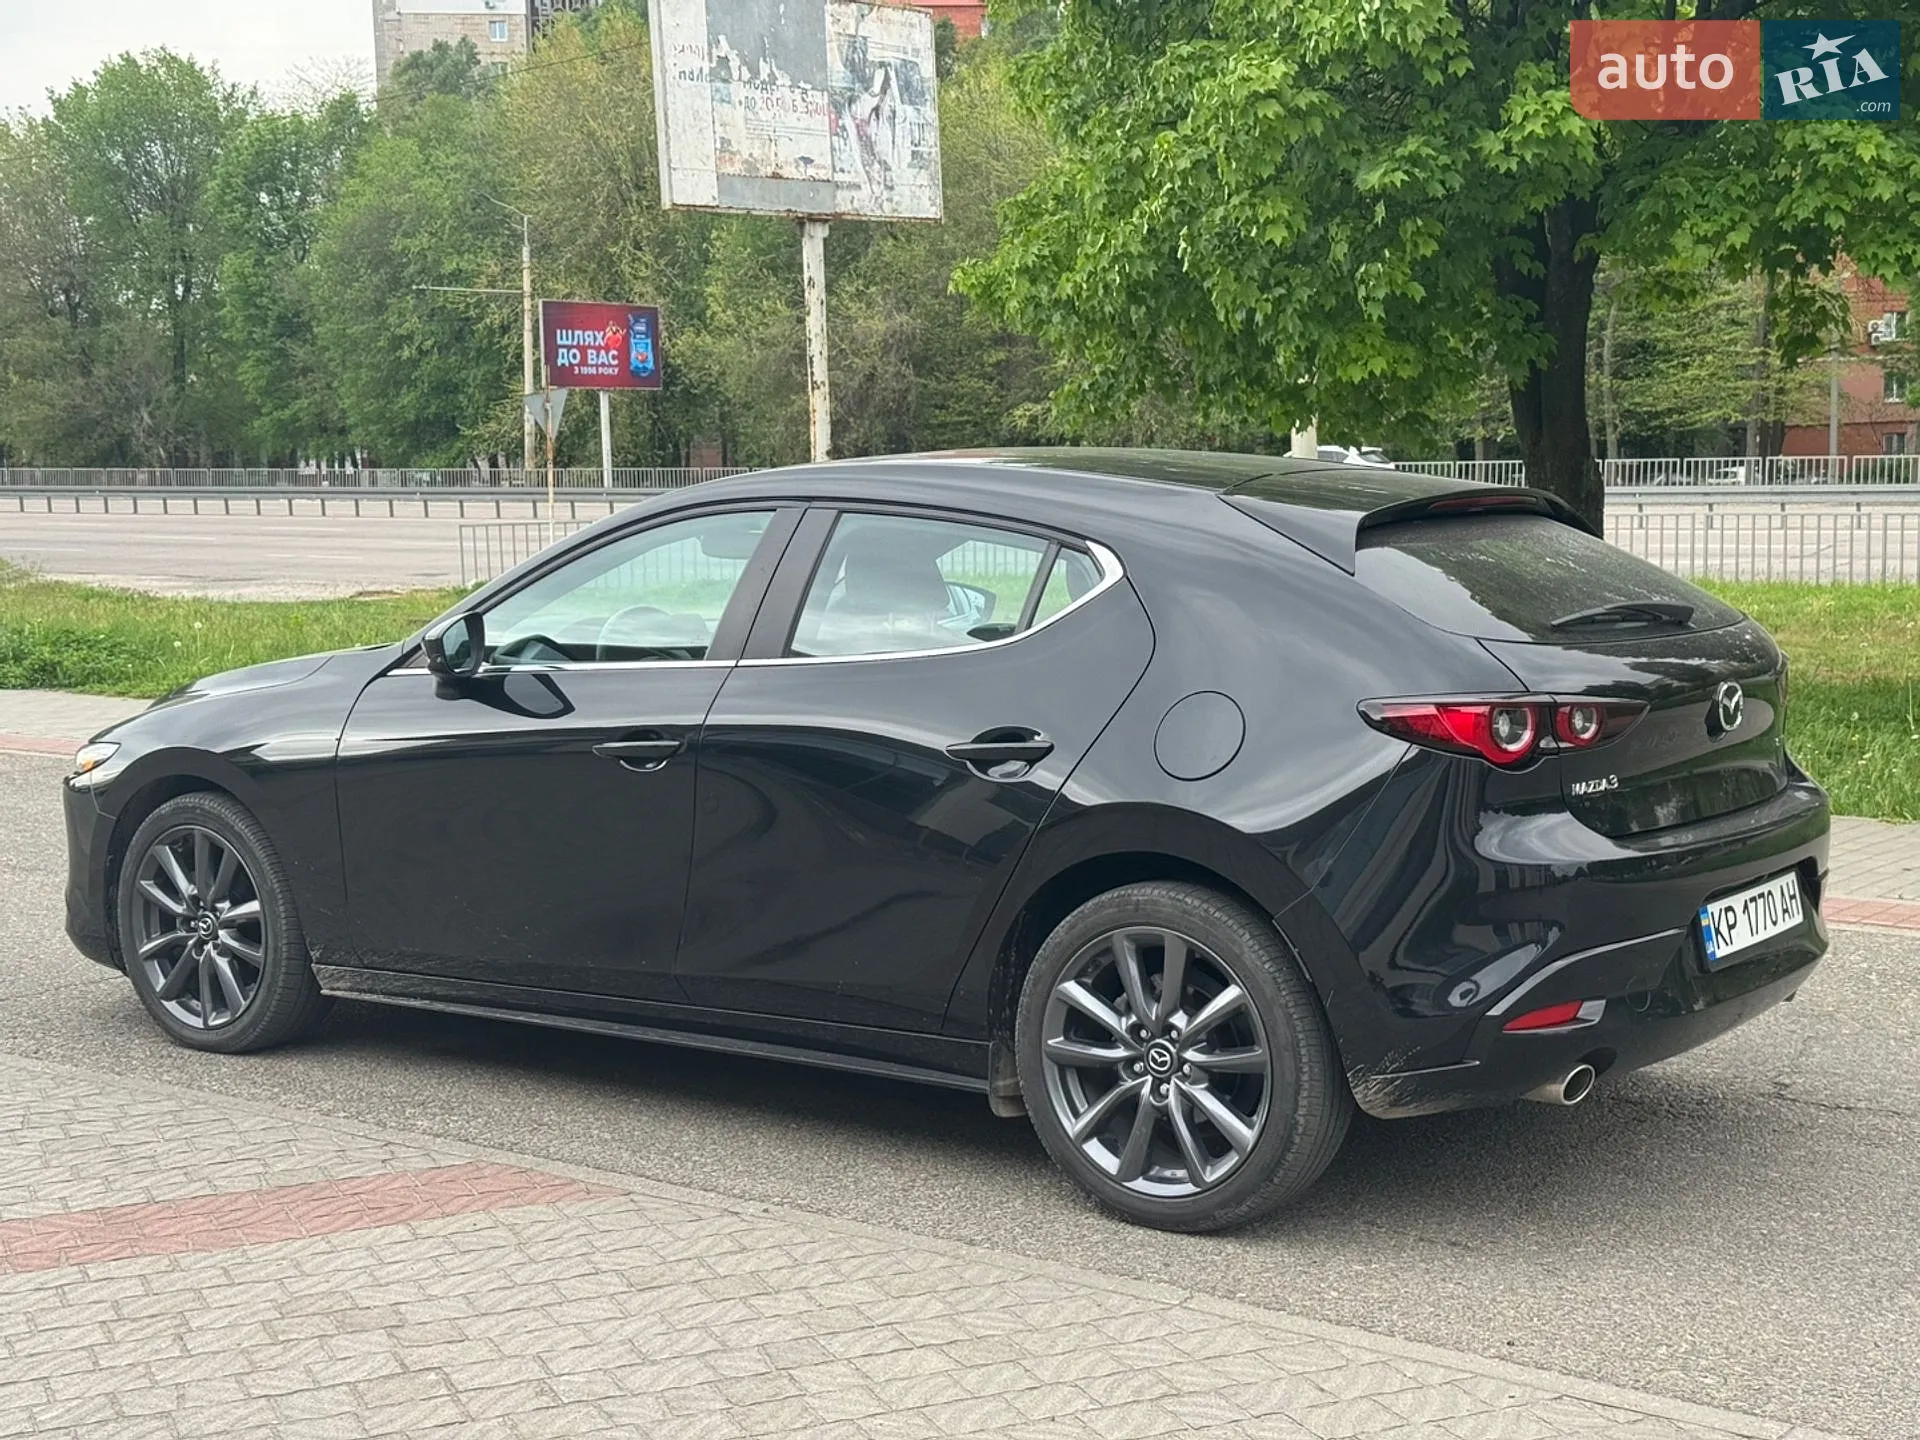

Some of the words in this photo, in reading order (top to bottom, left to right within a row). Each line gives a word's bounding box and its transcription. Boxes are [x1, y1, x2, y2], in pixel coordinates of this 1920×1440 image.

[556, 328, 605, 346] ШЛЯХ
[557, 348, 581, 367] ДО
[587, 350, 619, 365] ВАС
[598, 366, 620, 375] РОКУ
[1710, 905, 1737, 950] KP
[1742, 889, 1778, 937] 1770
[1779, 879, 1801, 923] AH
